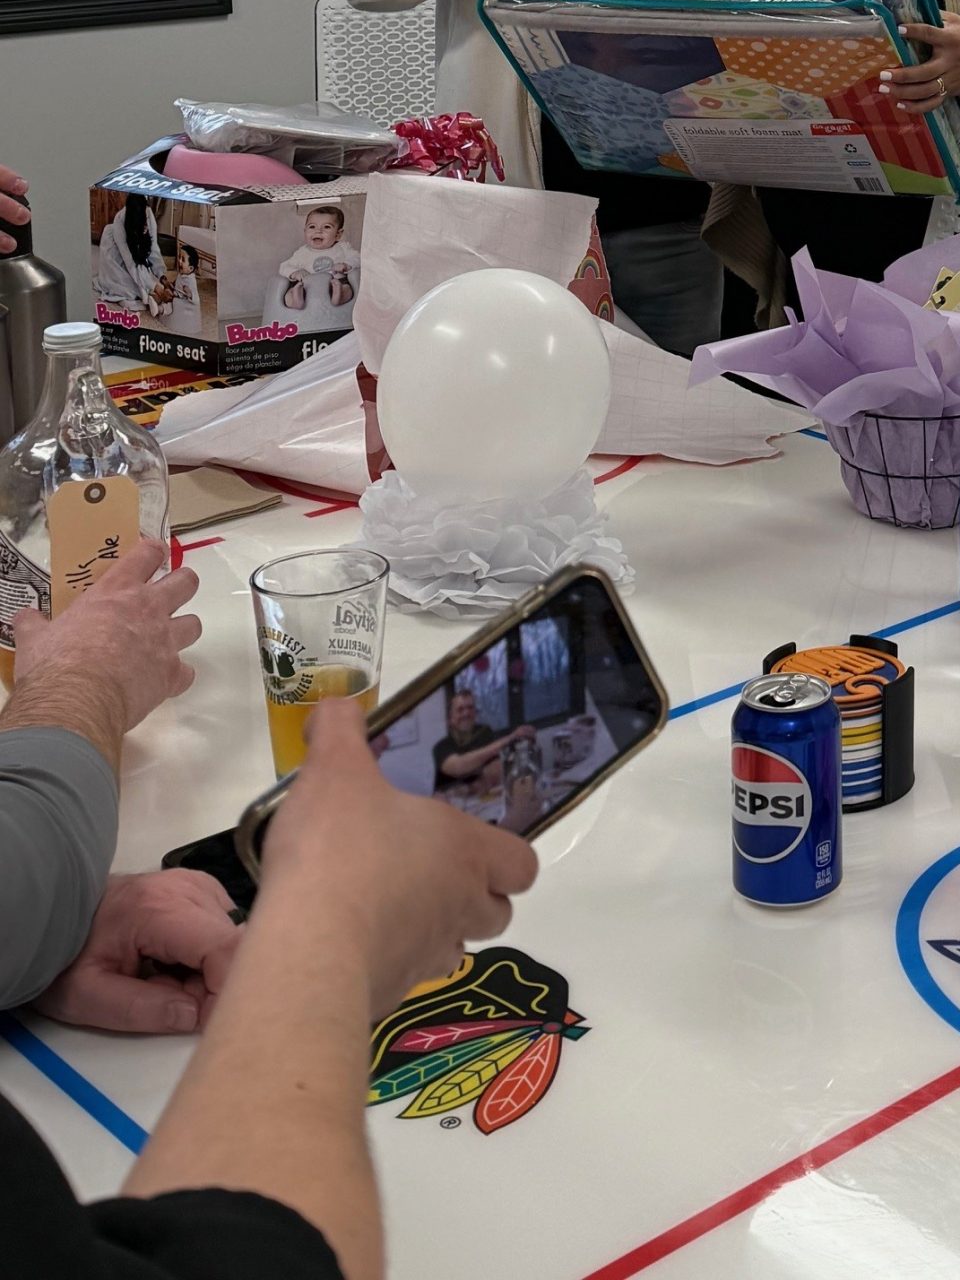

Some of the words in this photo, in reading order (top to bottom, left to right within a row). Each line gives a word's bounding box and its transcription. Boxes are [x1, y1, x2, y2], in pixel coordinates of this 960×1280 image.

[683, 126, 726, 137] foldable
[729, 127, 749, 136] soft
[751, 127, 779, 136] foam
[782, 128, 803, 136] mat
[103, 171, 172, 190] floor
[170, 183, 235, 201] seat
[96, 303, 140, 329] Bumbo
[139, 334, 172, 356] floor
[226, 322, 298, 345] Bumbo
[252, 352, 262, 360] de
[264, 352, 279, 360] piso
[98, 535, 119, 559] Ale
[732, 787, 804, 818] EPSI
